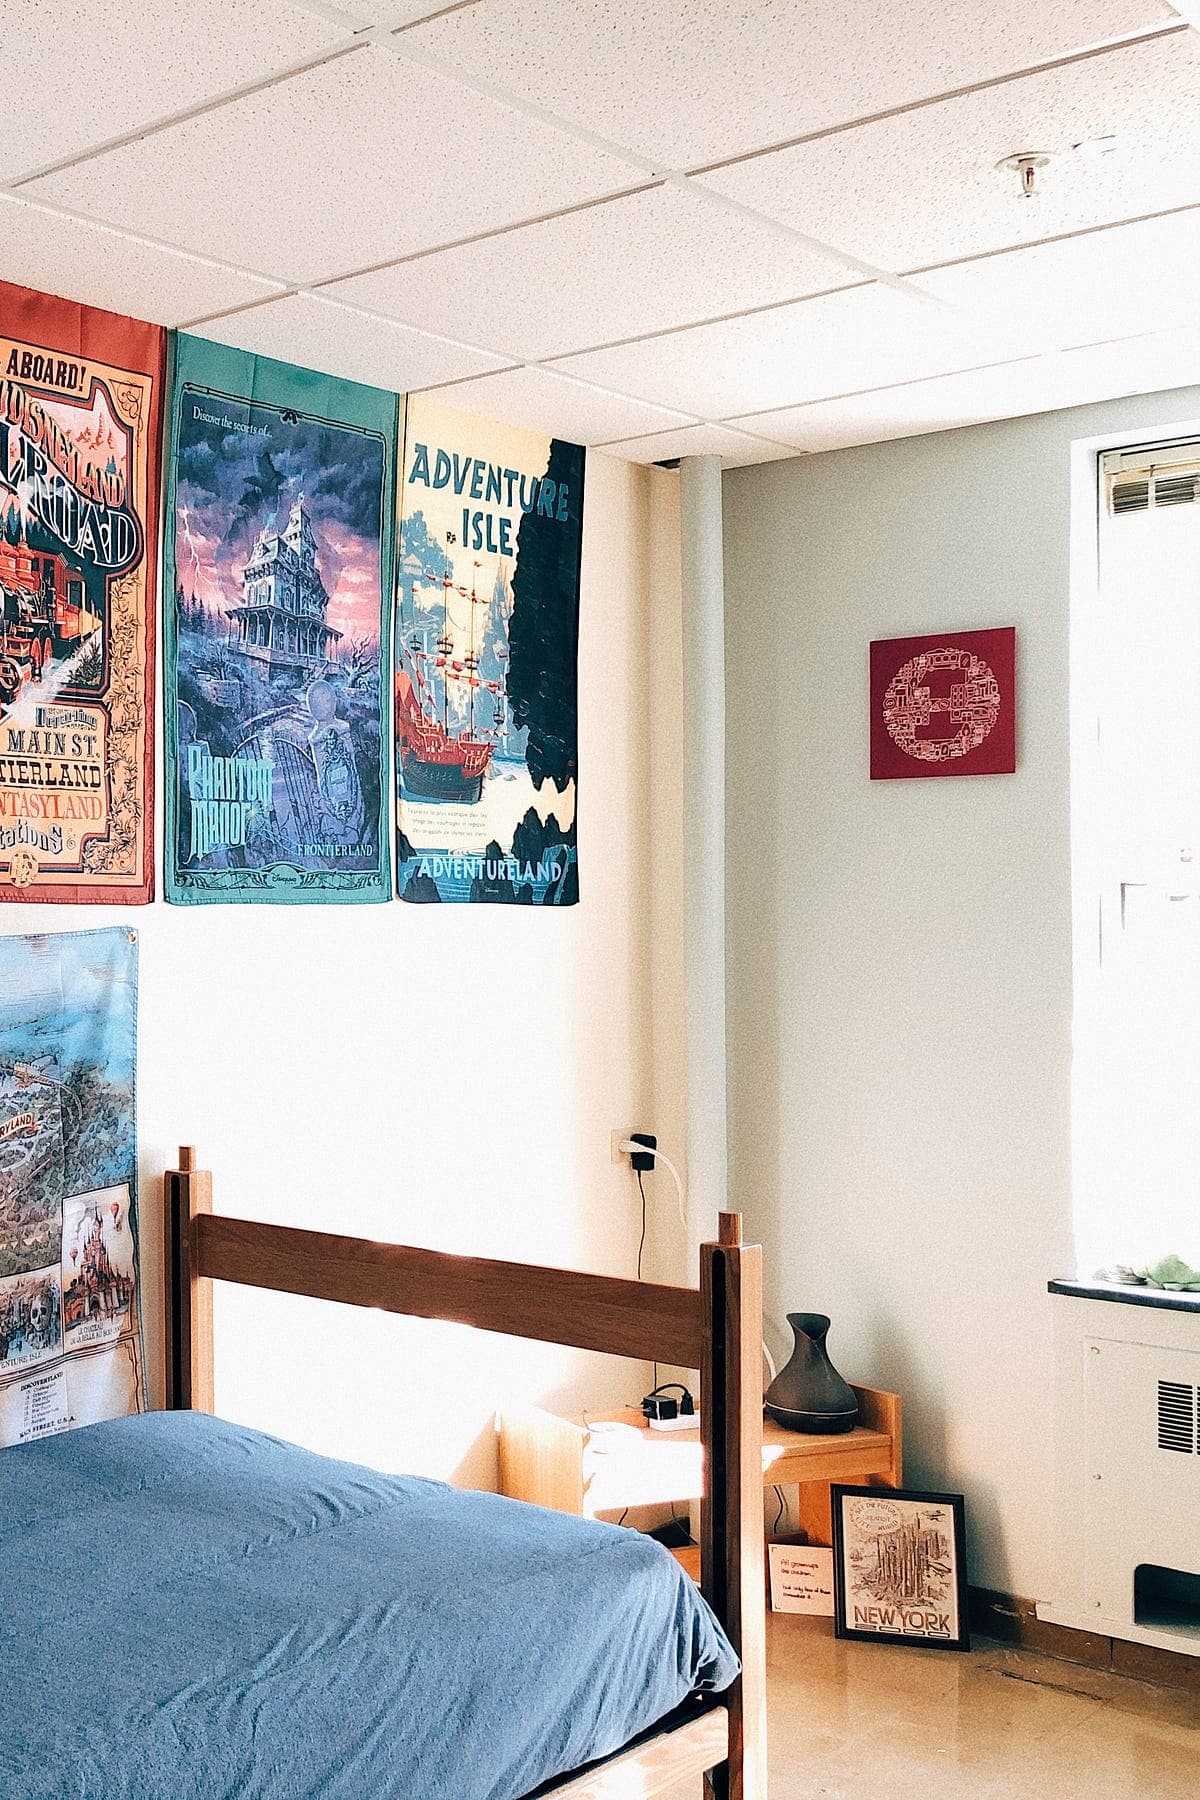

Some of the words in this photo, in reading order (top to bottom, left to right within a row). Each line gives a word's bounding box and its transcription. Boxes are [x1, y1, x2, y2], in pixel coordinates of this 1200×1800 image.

[6, 349, 86, 392] ABOARD!
[193, 406, 220, 425] Discover
[221, 415, 233, 429] the
[233, 420, 257, 436] secrets
[408, 442, 569, 522] ADVENTURE
[462, 508, 513, 557] ISLE
[7, 728, 66, 755] MAIN
[72, 733, 100, 758] ST.
[297, 844, 373, 857] FRONTIERLAND
[417, 857, 562, 882] ADVENTURELAND
[854, 1605, 896, 1627] NEW
[900, 1612, 950, 1632] YORK
